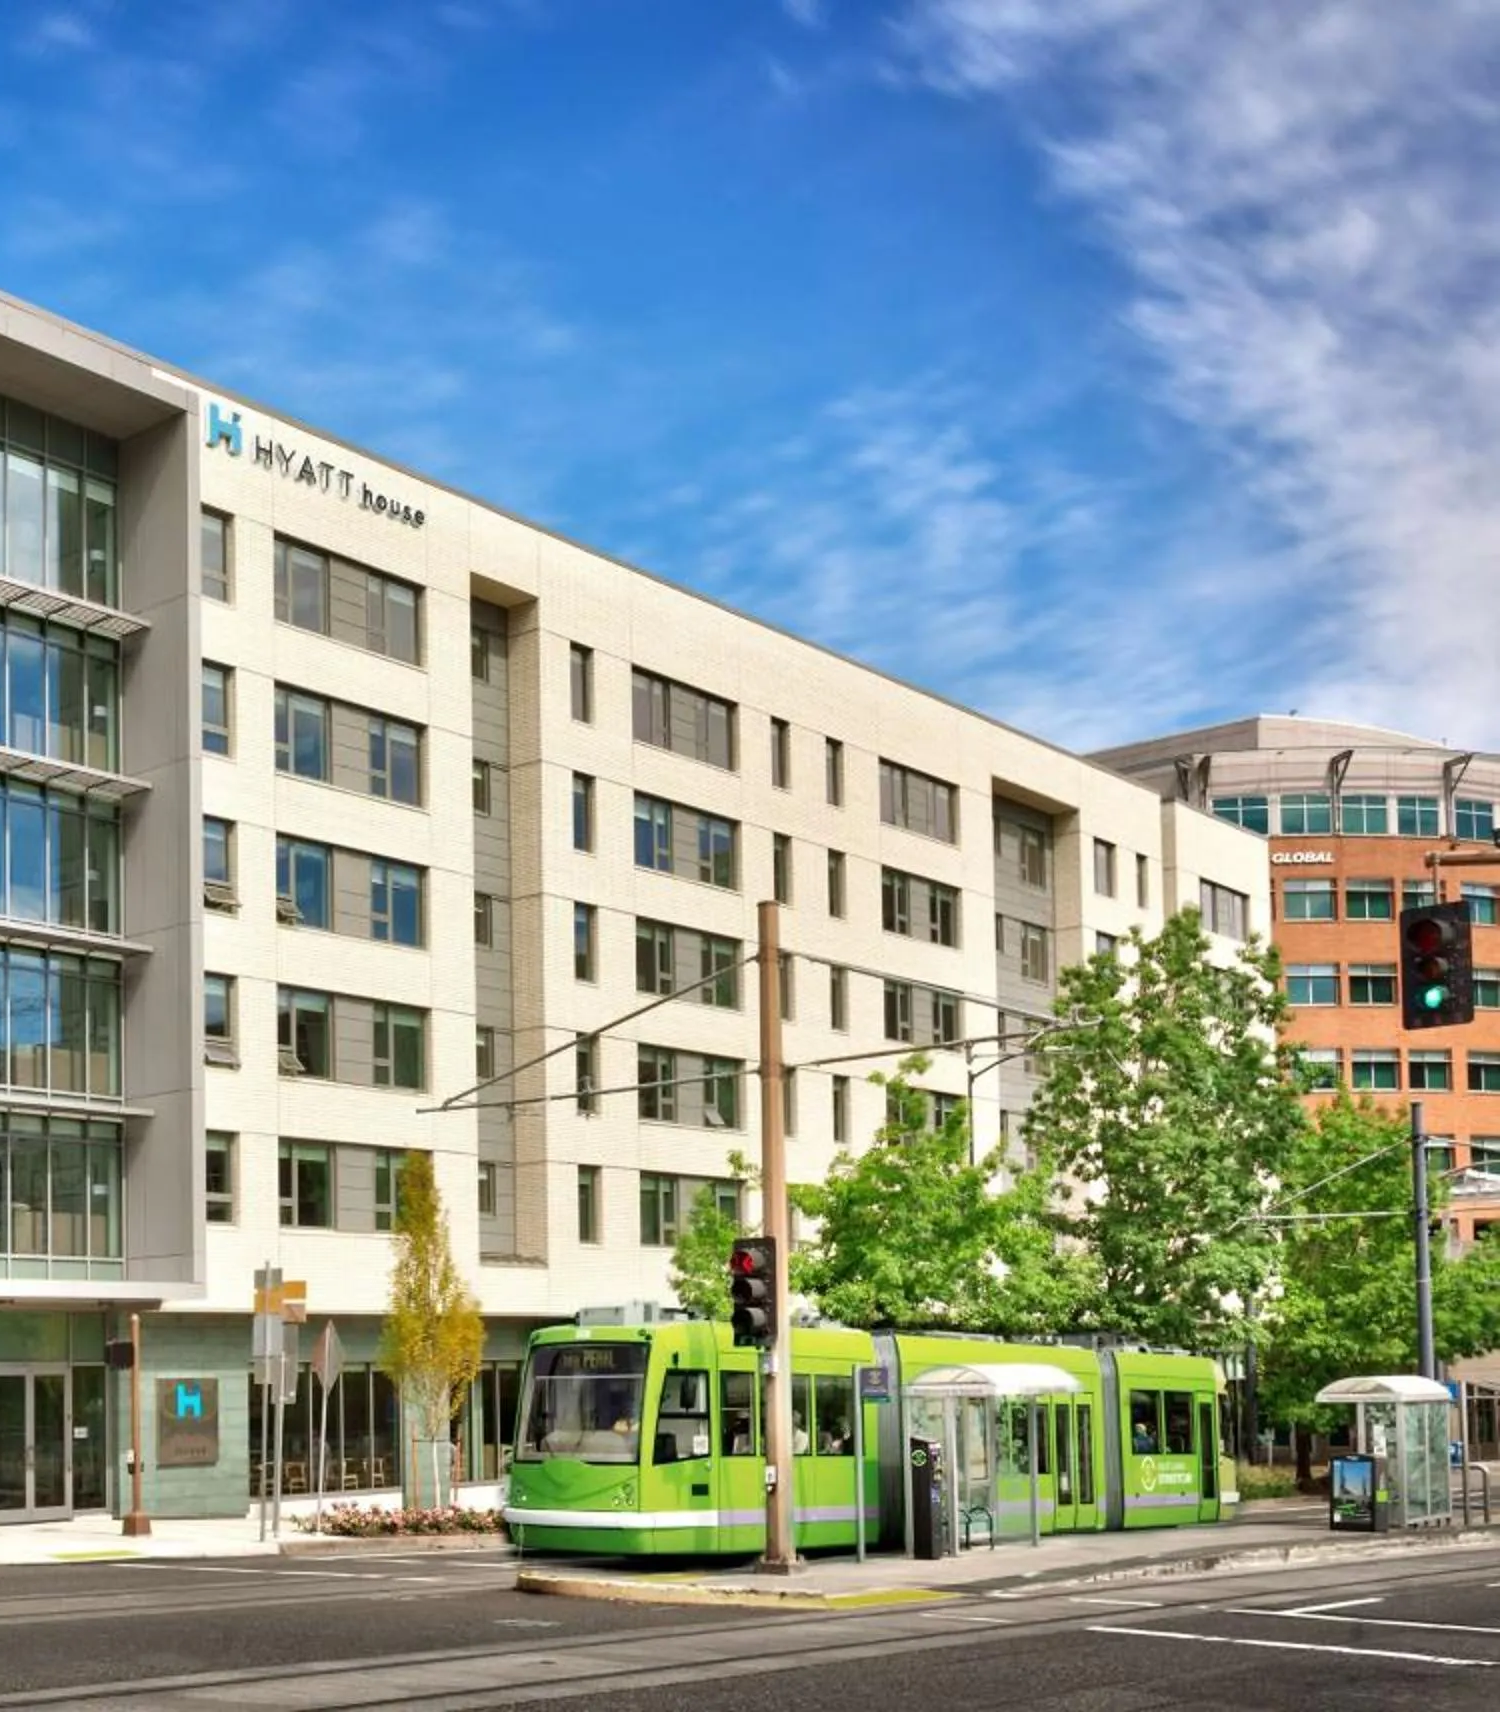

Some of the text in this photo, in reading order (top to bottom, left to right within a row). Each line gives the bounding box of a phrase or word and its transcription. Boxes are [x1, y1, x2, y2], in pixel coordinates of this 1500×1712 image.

[254, 435, 354, 498] HYATT
[360, 482, 426, 527] house
[1271, 851, 1335, 863] GLOBAL
